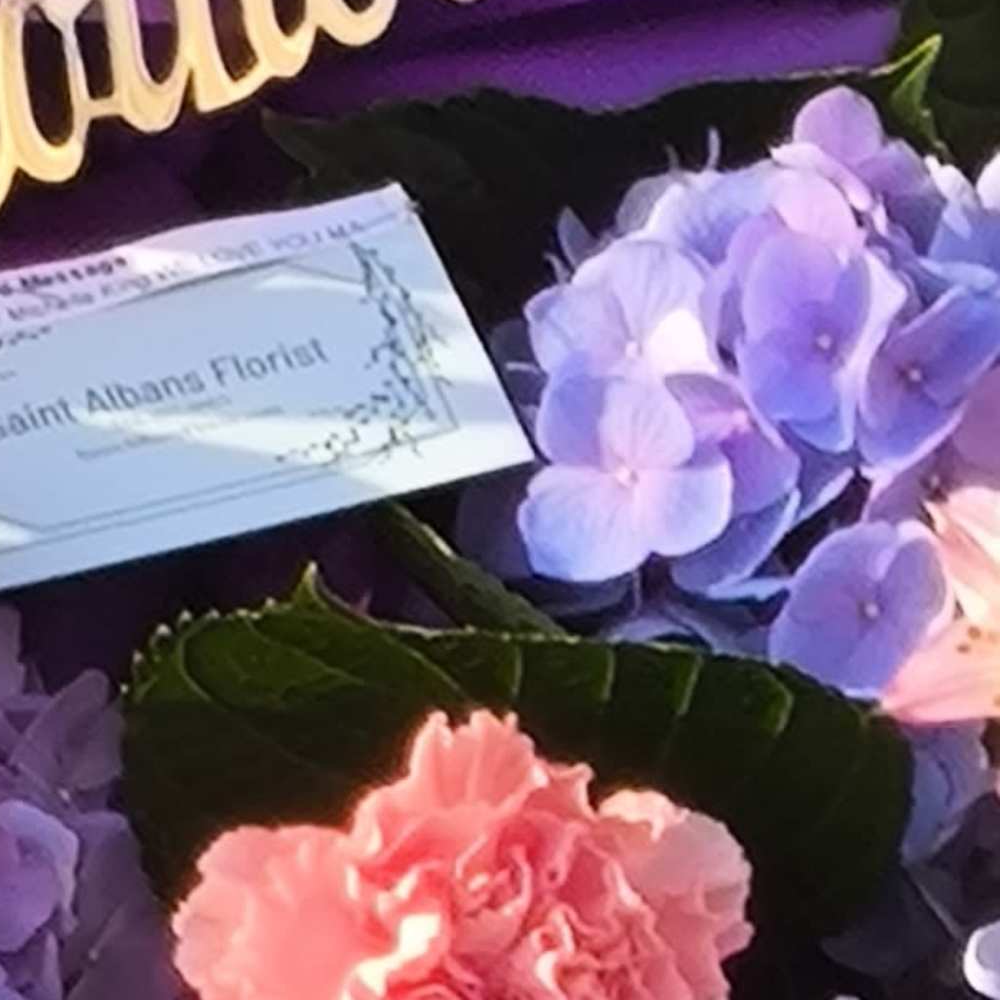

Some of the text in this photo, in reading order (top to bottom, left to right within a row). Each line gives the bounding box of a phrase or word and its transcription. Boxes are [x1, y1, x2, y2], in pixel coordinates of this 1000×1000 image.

[18, 255, 128, 292] Message
[83, 368, 206, 416] Albans
[209, 337, 328, 386] Florist
